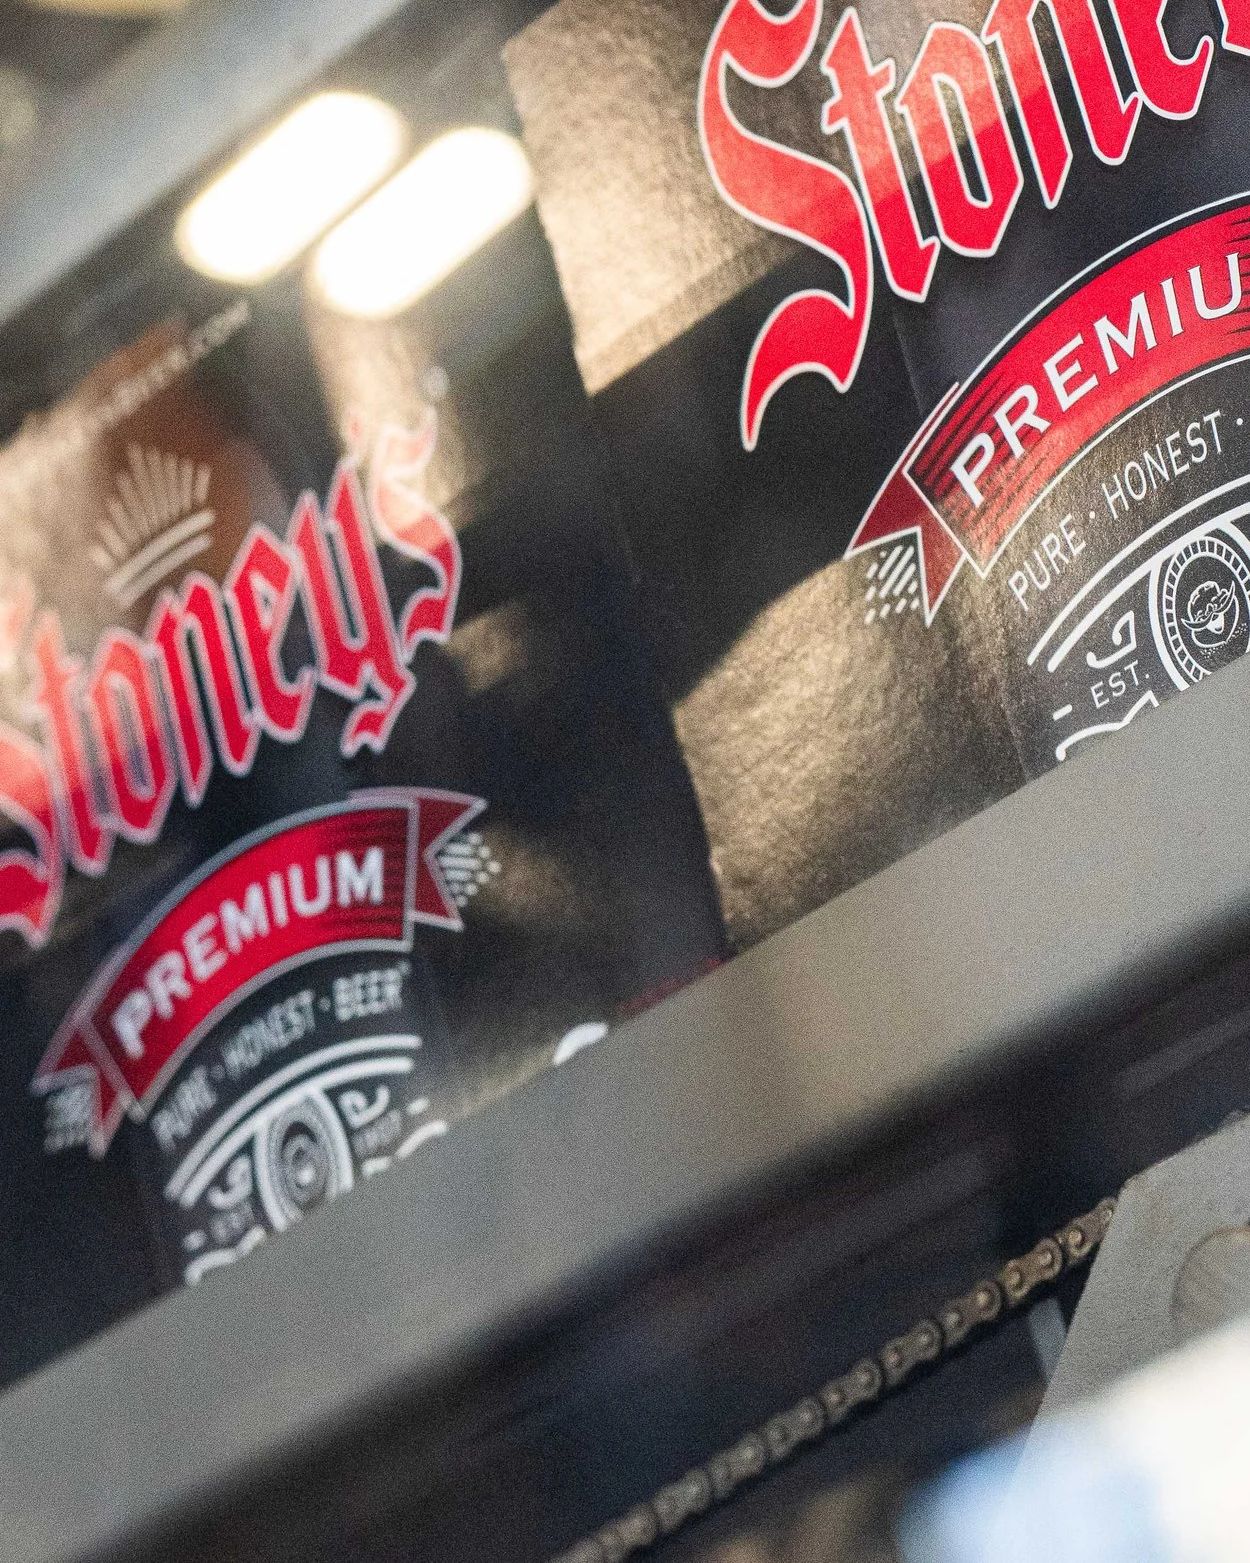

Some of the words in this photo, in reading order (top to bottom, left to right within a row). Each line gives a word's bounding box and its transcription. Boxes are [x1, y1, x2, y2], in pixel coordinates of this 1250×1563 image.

[1006, 512, 1087, 610] PURE
[1101, 410, 1223, 519] HONEST
[1090, 659, 1151, 709] EST.
[110, 846, 386, 1061] PREMIUM
